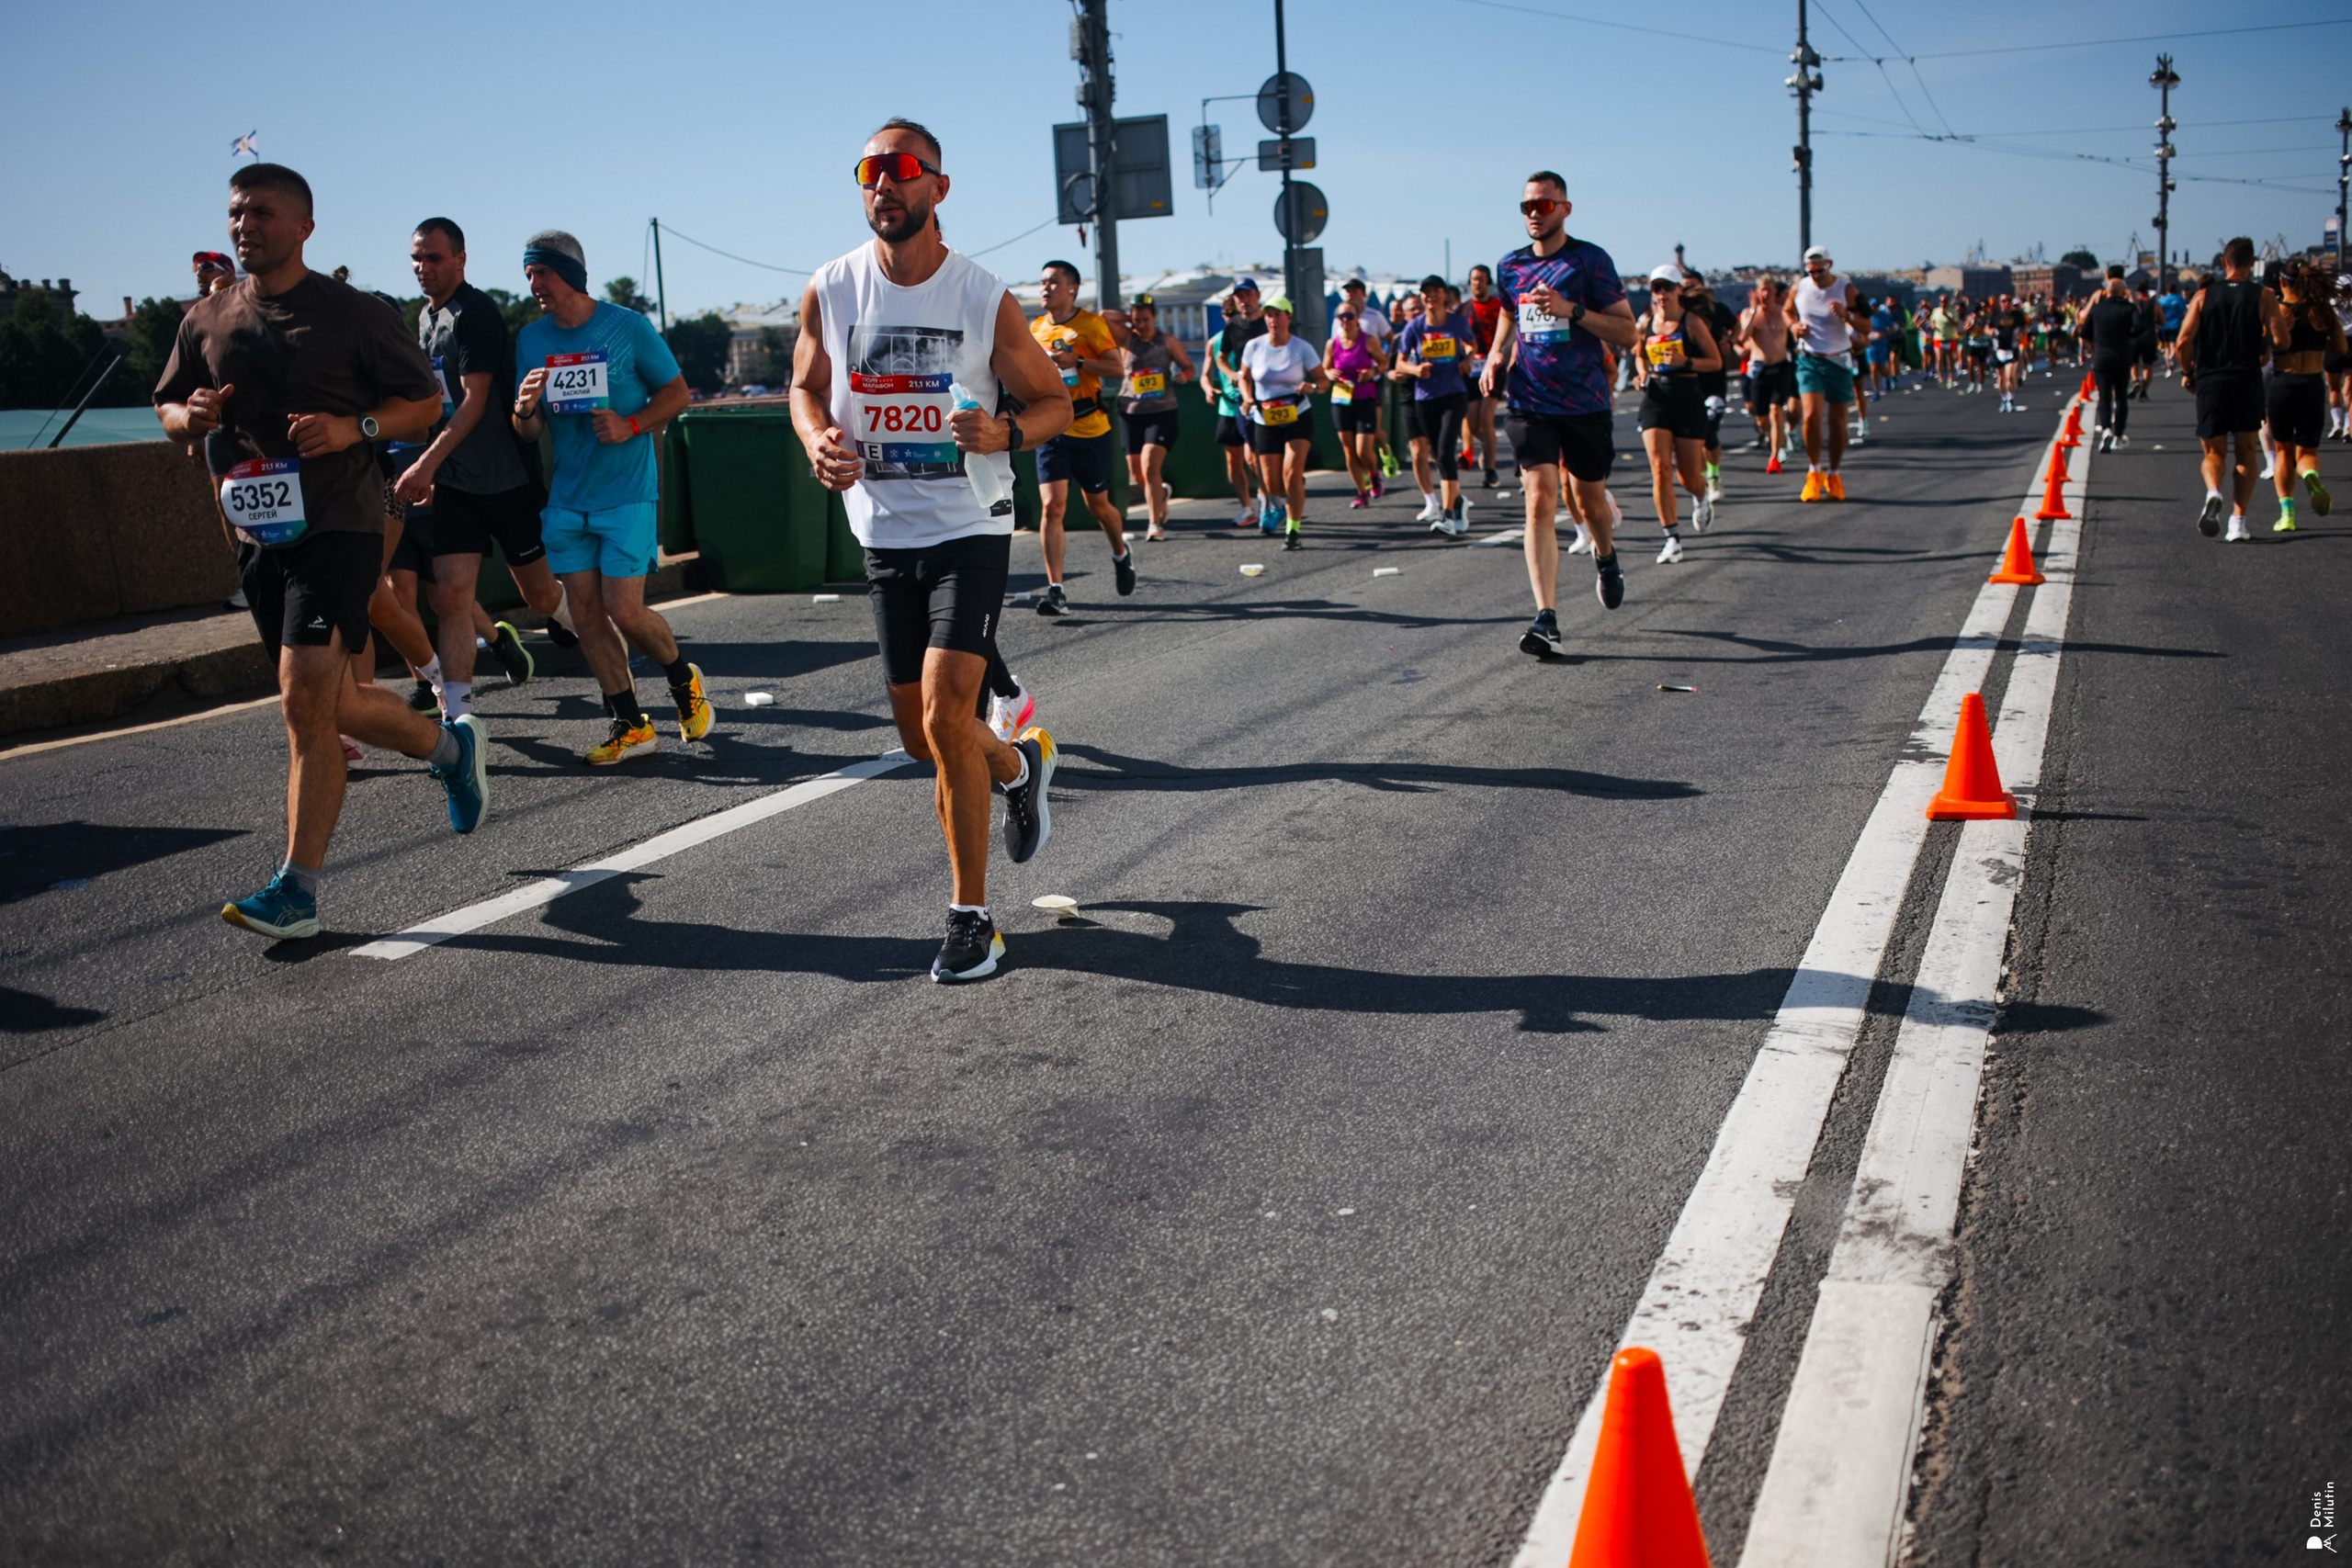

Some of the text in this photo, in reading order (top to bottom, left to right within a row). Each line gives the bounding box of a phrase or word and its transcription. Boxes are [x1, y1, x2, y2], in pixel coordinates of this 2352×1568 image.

[553, 367, 596, 389] 4231
[562, 388, 591, 397] ВАСИЛИЙ
[552, 402, 560, 413] D
[864, 405, 942, 433] 7820
[868, 445, 879, 459] E
[260, 462, 274, 471] 21,1
[231, 480, 292, 513] 5352
[248, 509, 277, 521] СЕРГЕЙ
